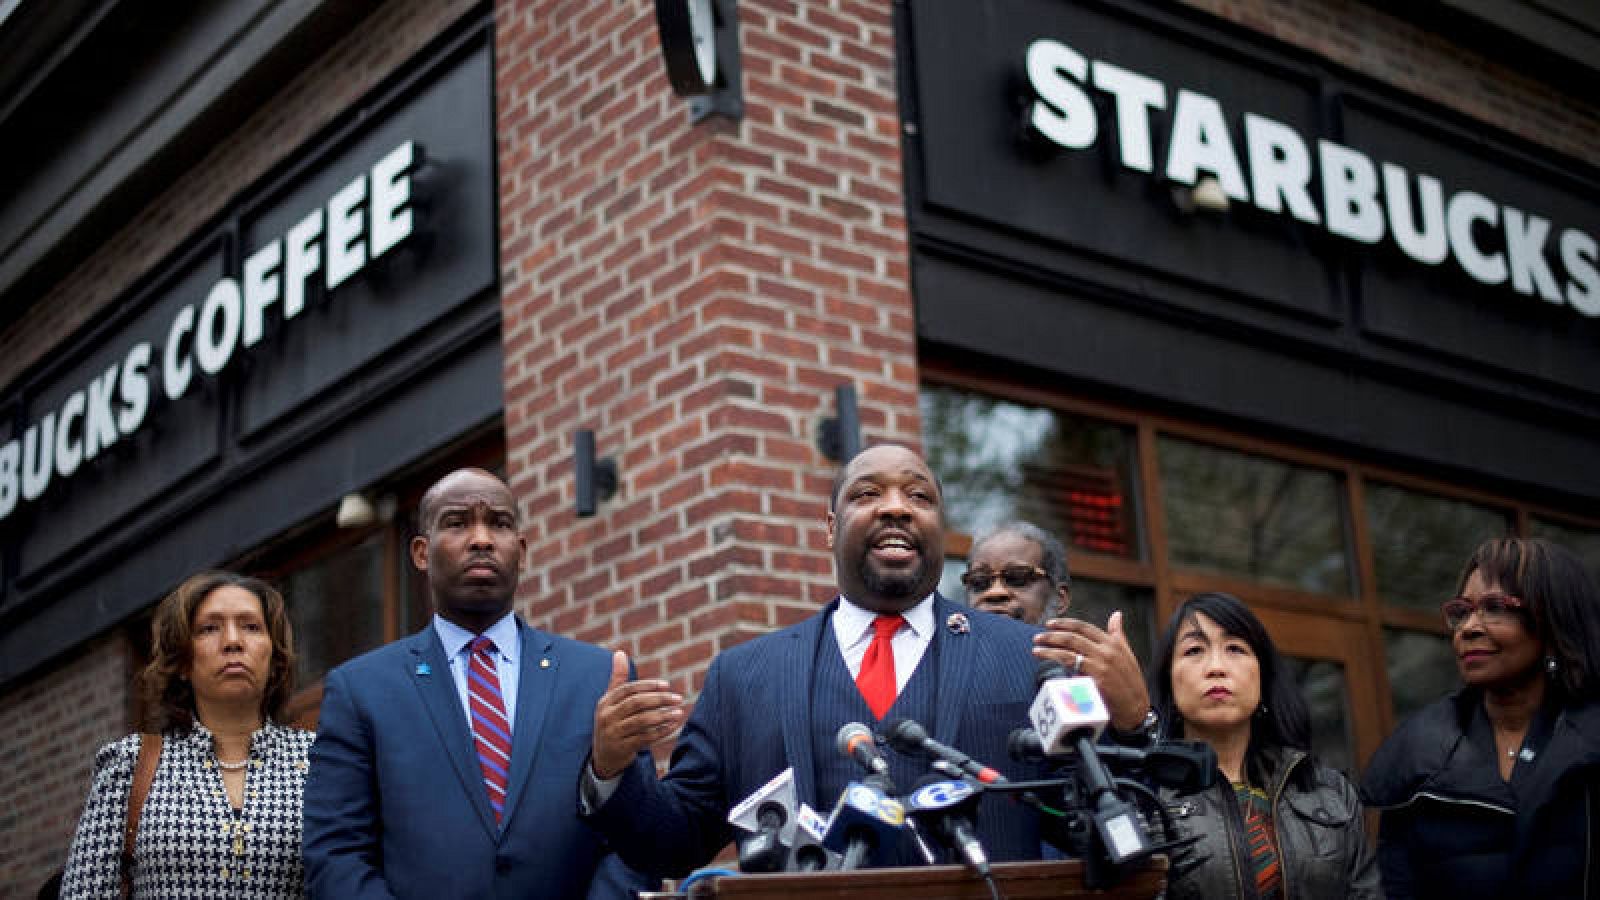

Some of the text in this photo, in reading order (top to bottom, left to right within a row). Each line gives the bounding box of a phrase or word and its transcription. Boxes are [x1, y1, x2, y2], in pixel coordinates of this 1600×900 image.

[0, 139, 414, 519] BUCKS COFFEE
[1025, 38, 1600, 317] STARBUCKS
